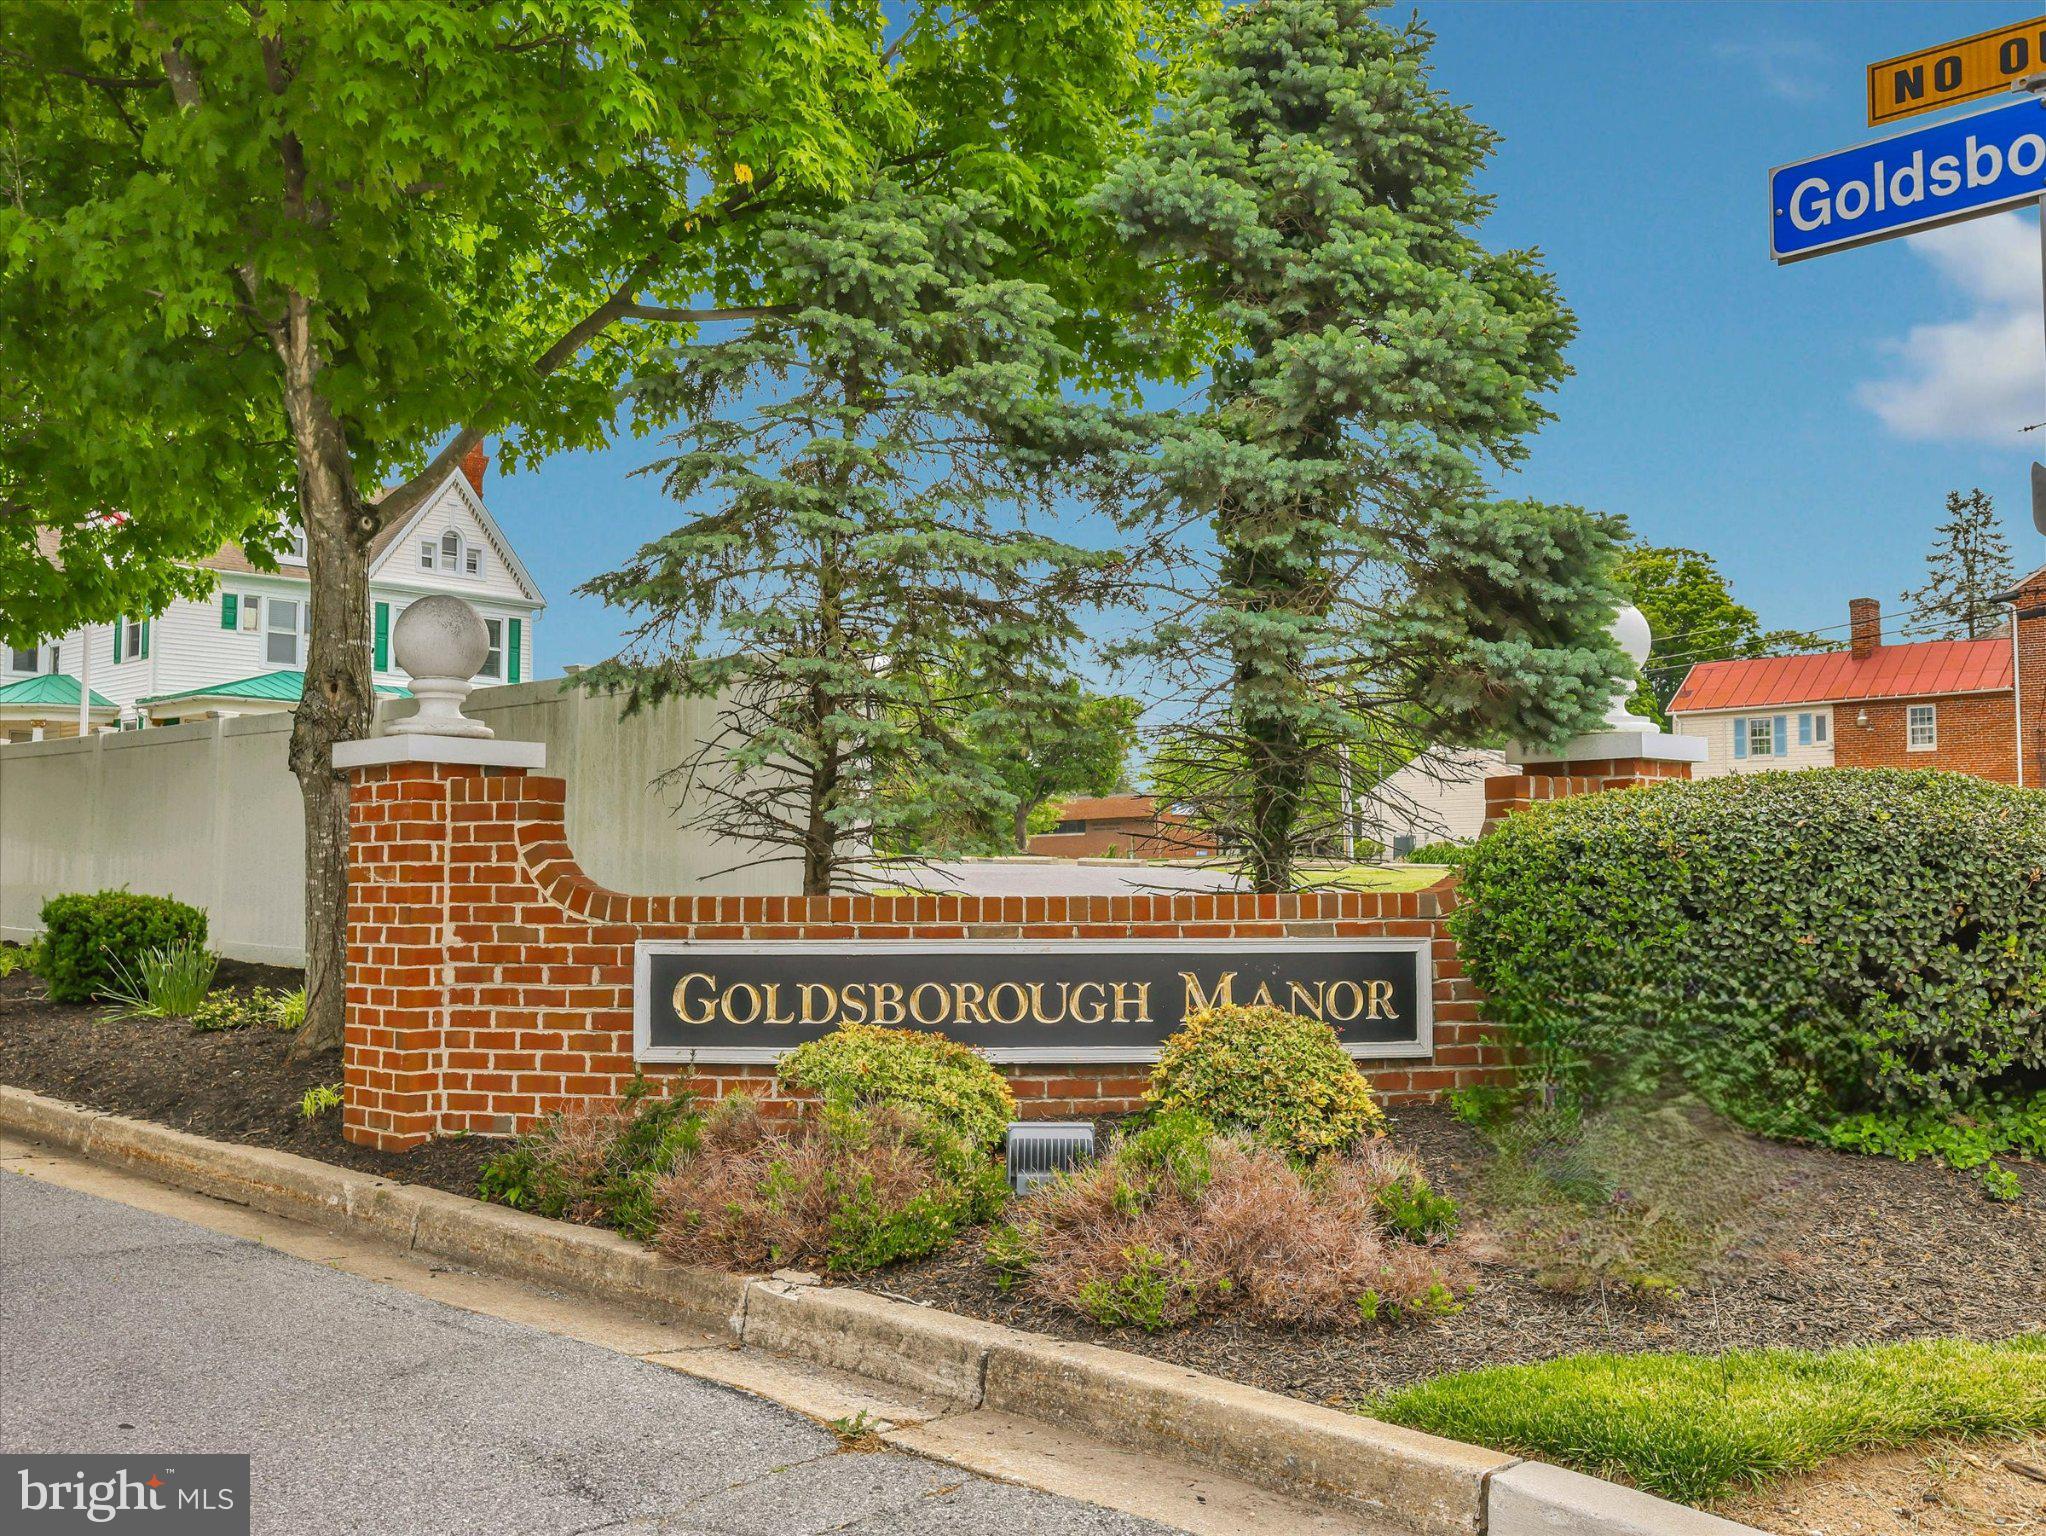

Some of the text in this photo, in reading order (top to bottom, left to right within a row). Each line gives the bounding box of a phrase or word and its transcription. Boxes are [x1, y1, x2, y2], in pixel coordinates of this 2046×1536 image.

[1894, 31, 2046, 105] NO O
[1789, 133, 2046, 232] Goldsbo
[672, 971, 1154, 1025] GOLDSBOROUGH
